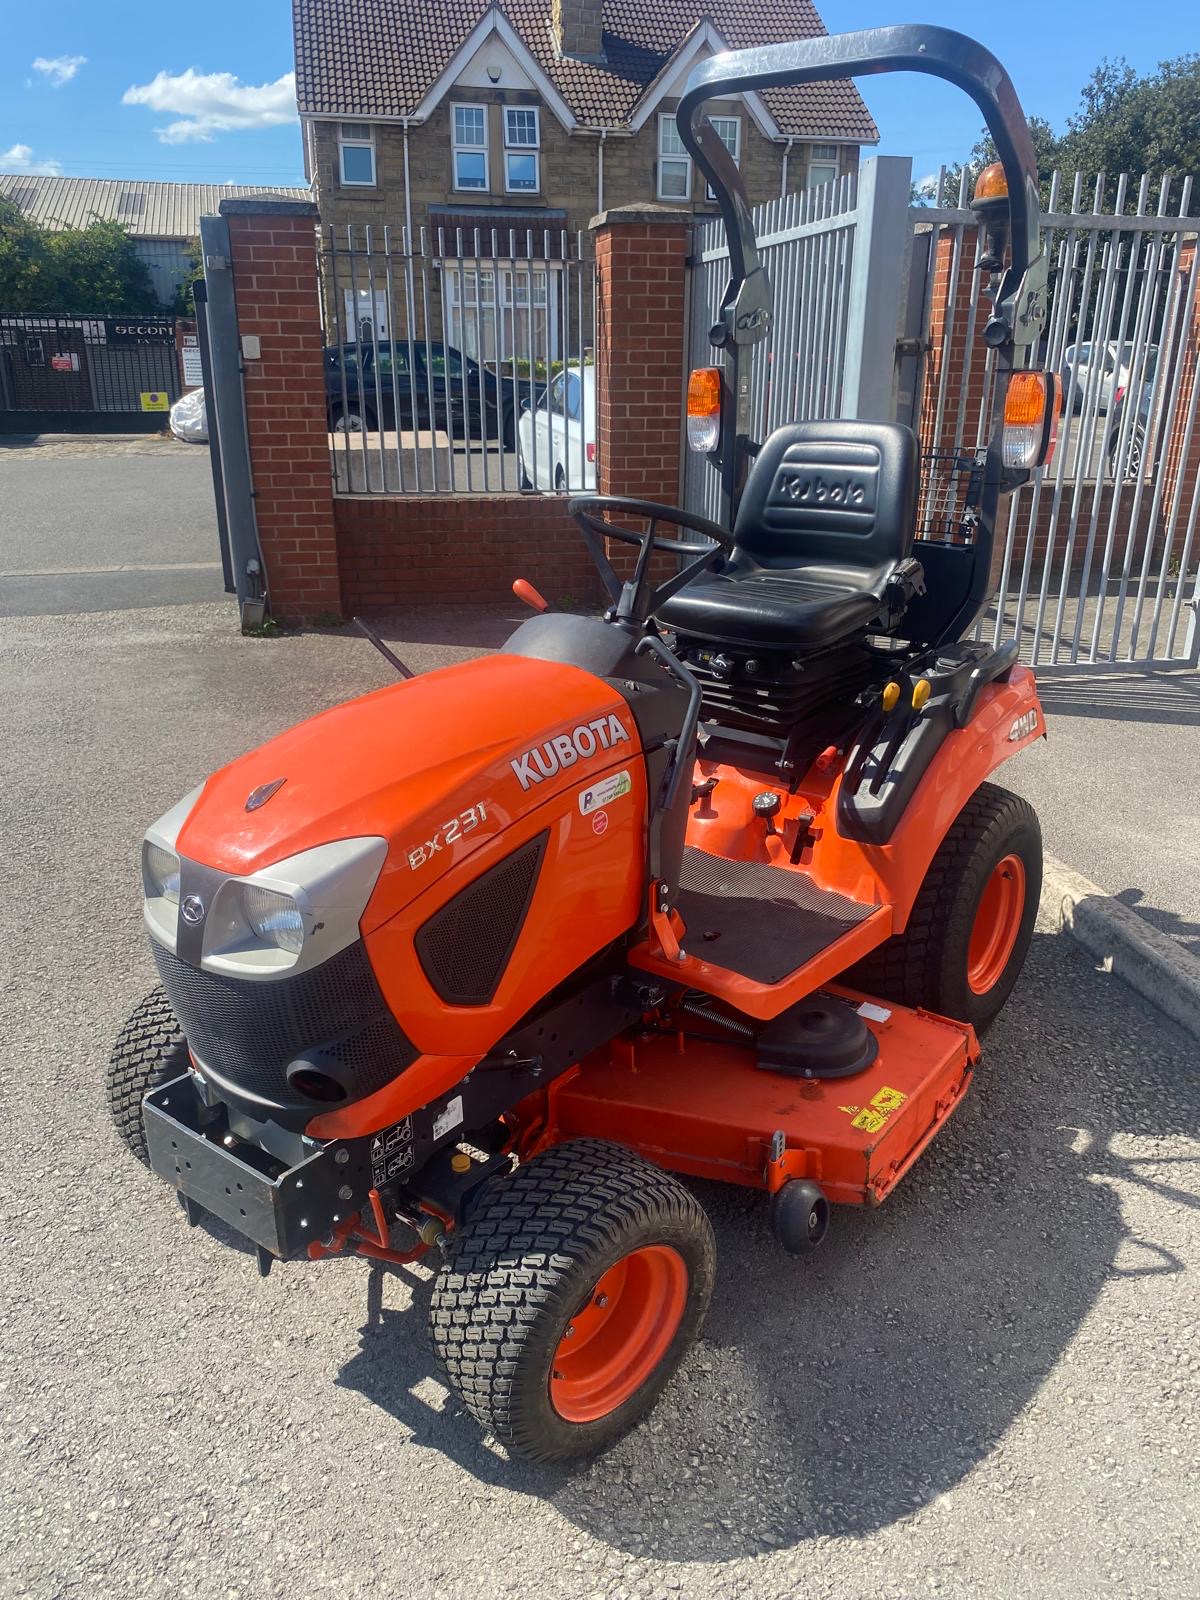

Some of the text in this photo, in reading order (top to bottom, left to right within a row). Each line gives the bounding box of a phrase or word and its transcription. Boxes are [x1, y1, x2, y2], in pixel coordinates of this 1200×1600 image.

[779, 474, 865, 504] Kubota
[1008, 708, 1037, 741] 4WD
[509, 713, 630, 792] KUBOTA
